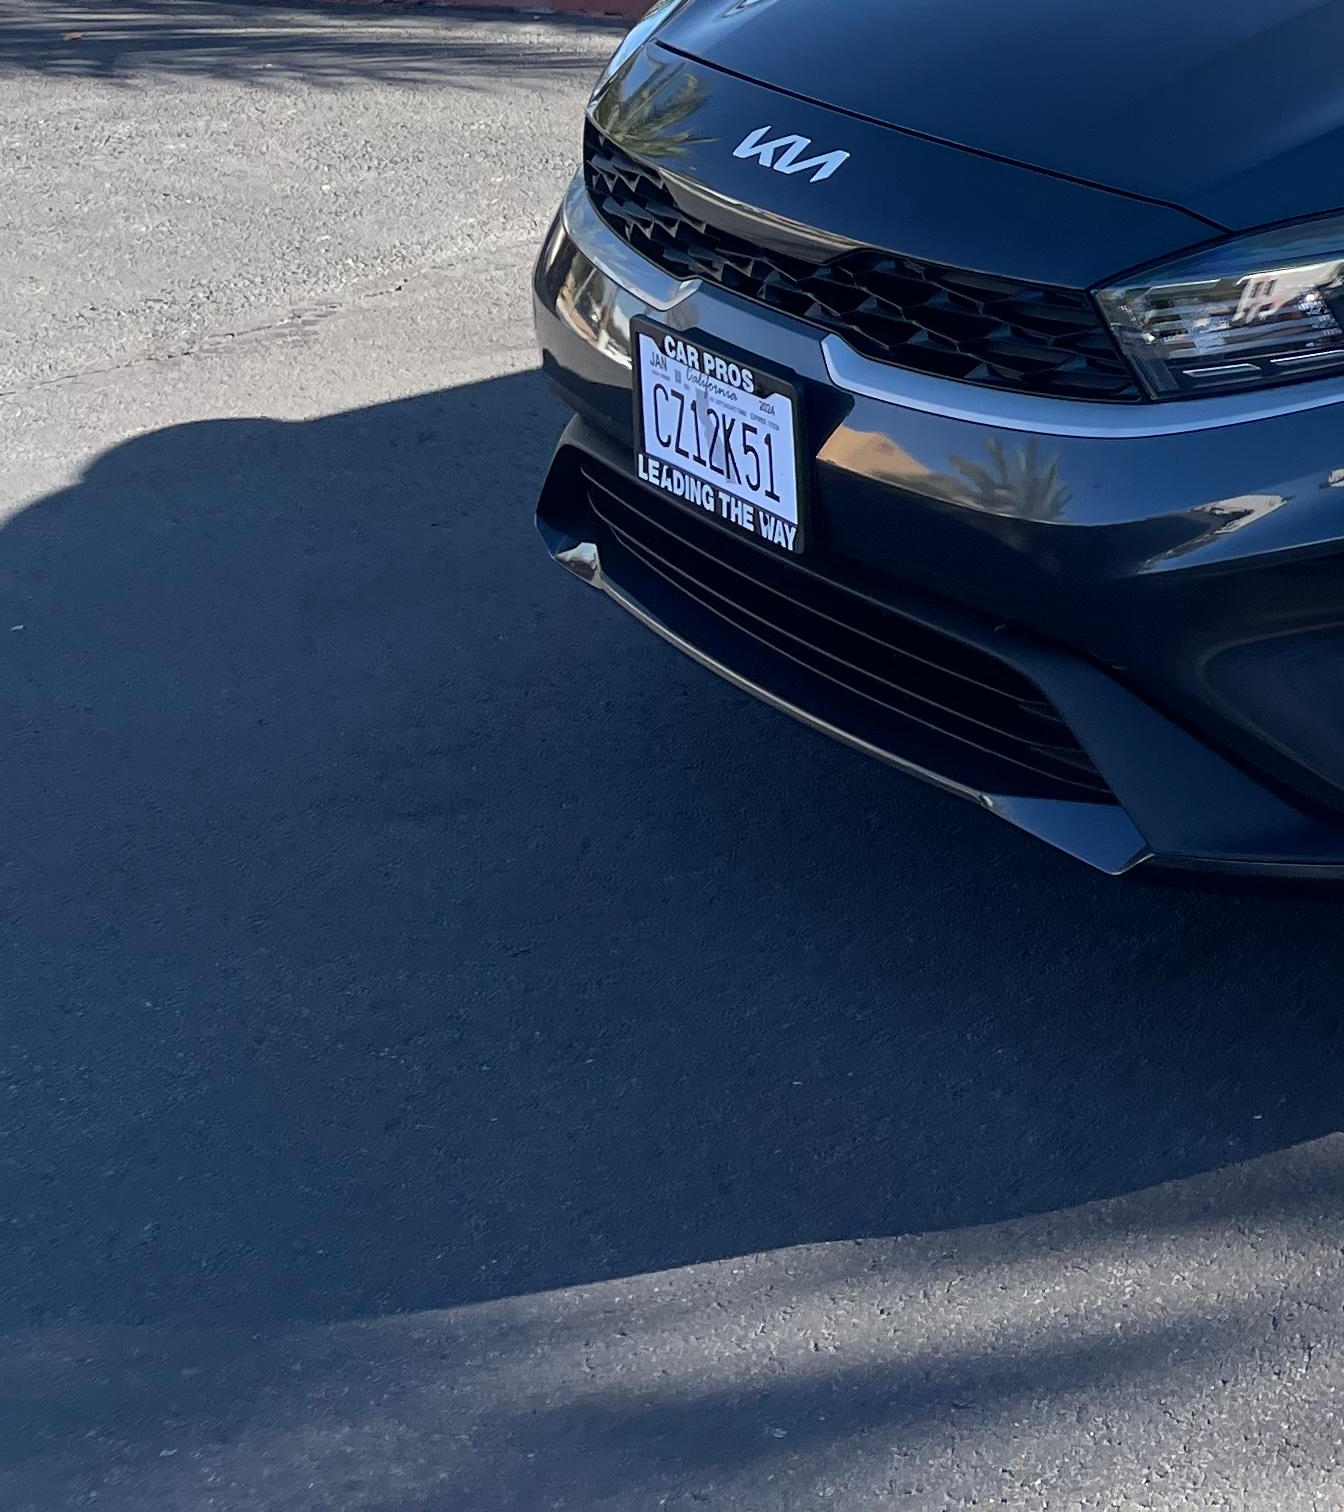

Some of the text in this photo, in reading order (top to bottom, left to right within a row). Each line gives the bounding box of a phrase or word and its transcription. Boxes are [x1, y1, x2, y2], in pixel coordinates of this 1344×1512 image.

[732, 125, 850, 183] KIA
[650, 351, 668, 371] JAN
[664, 335, 754, 393] CAR PROS
[653, 383, 780, 502] CZ12K51
[638, 453, 797, 551] LEADING THE WAY
